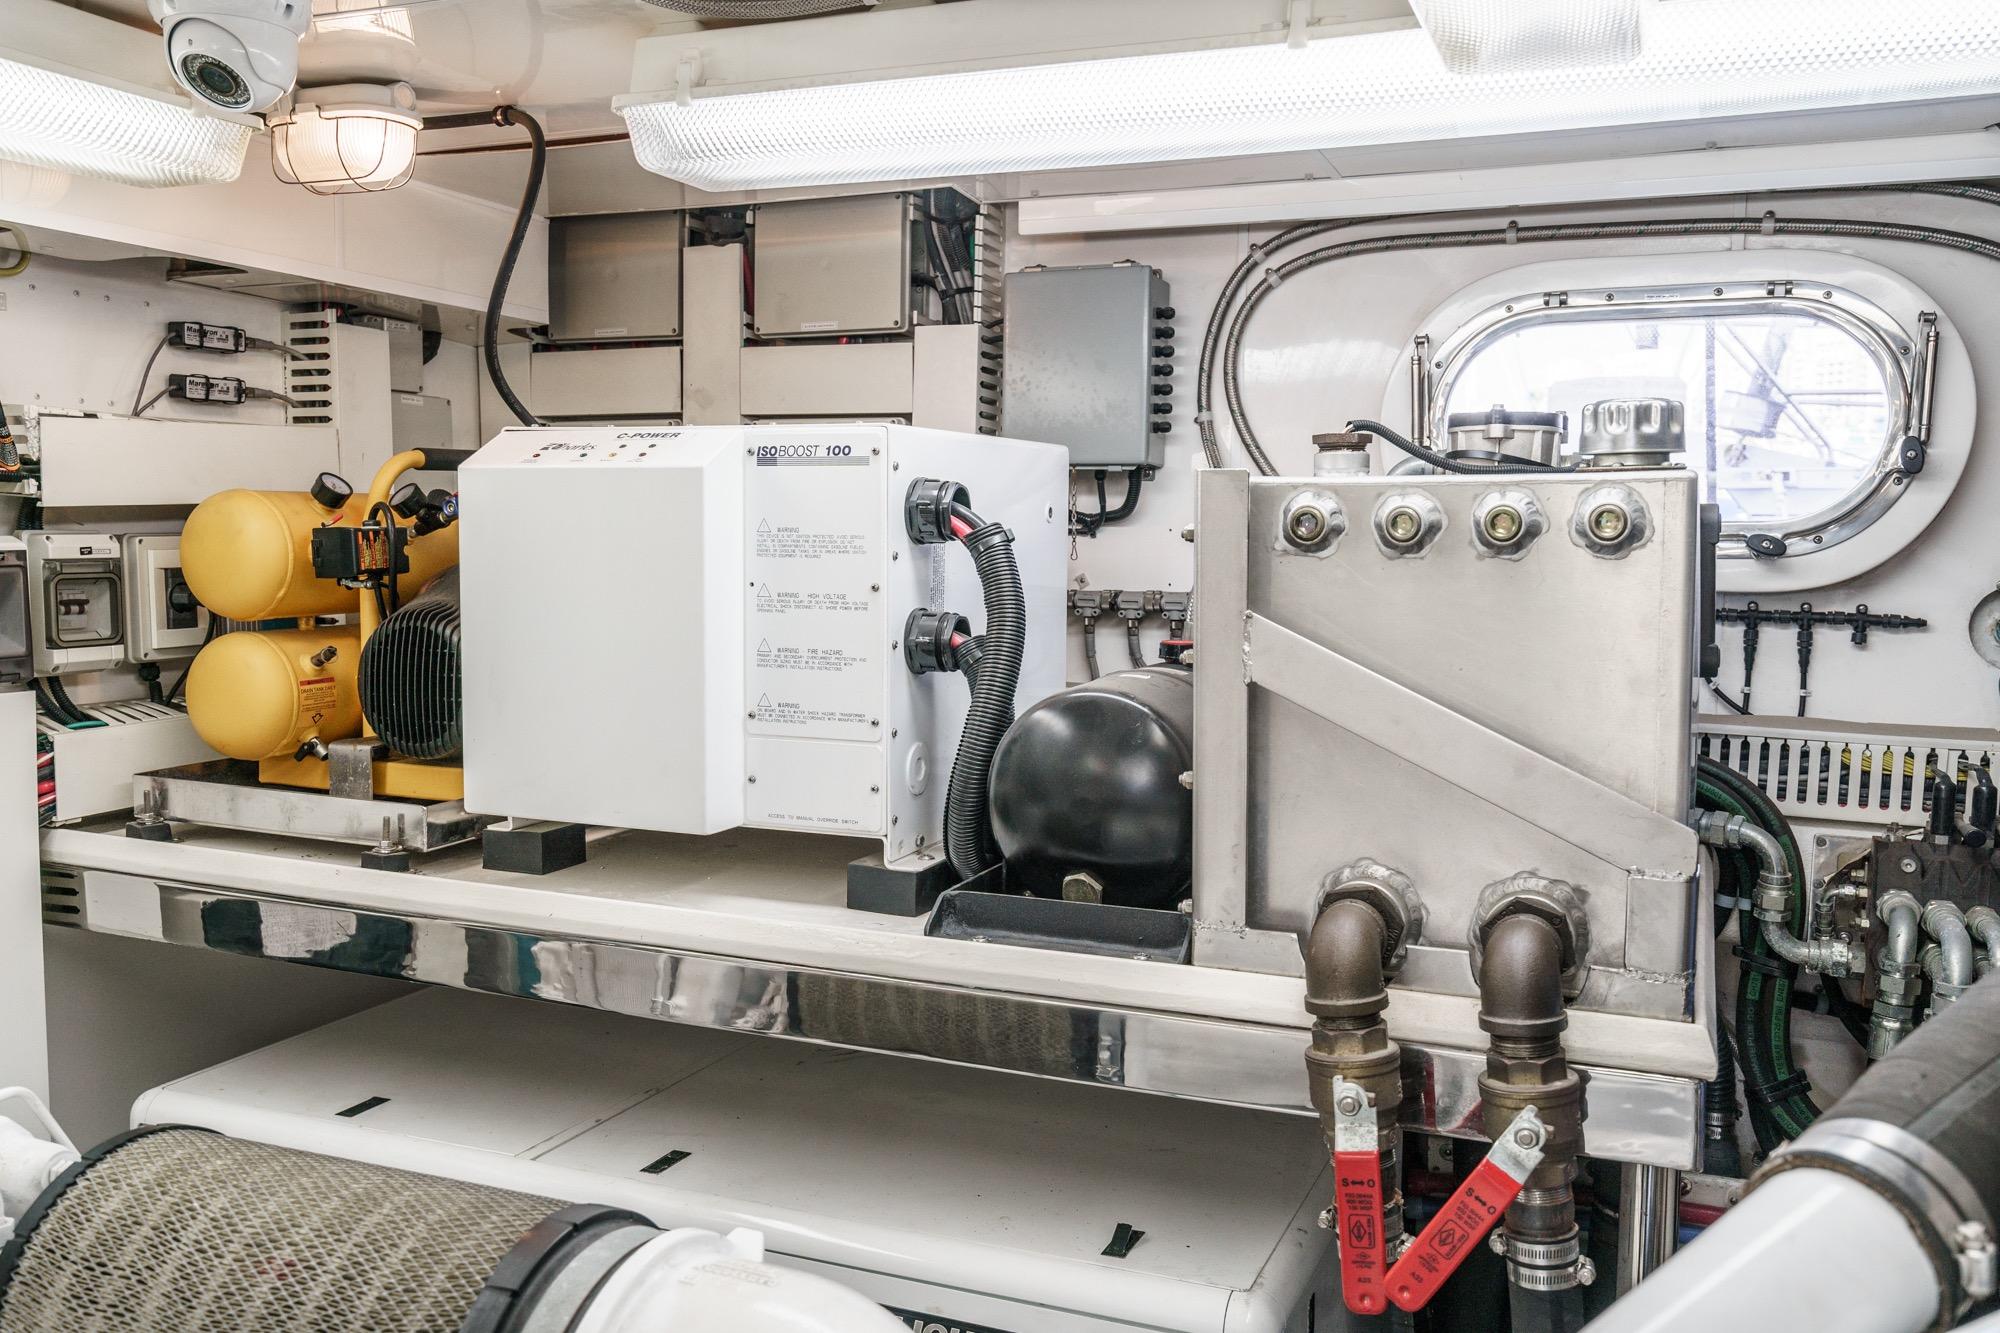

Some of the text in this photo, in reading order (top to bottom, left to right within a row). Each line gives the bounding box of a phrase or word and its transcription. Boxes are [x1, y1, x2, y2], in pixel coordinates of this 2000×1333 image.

[186, 326, 218, 336] Martron
[756, 445, 852, 457] ISOBOOST 100
[1342, 1178, 1376, 1188] S O
[1466, 1188, 1474, 1197] S
[1488, 1206, 1496, 1215] O
